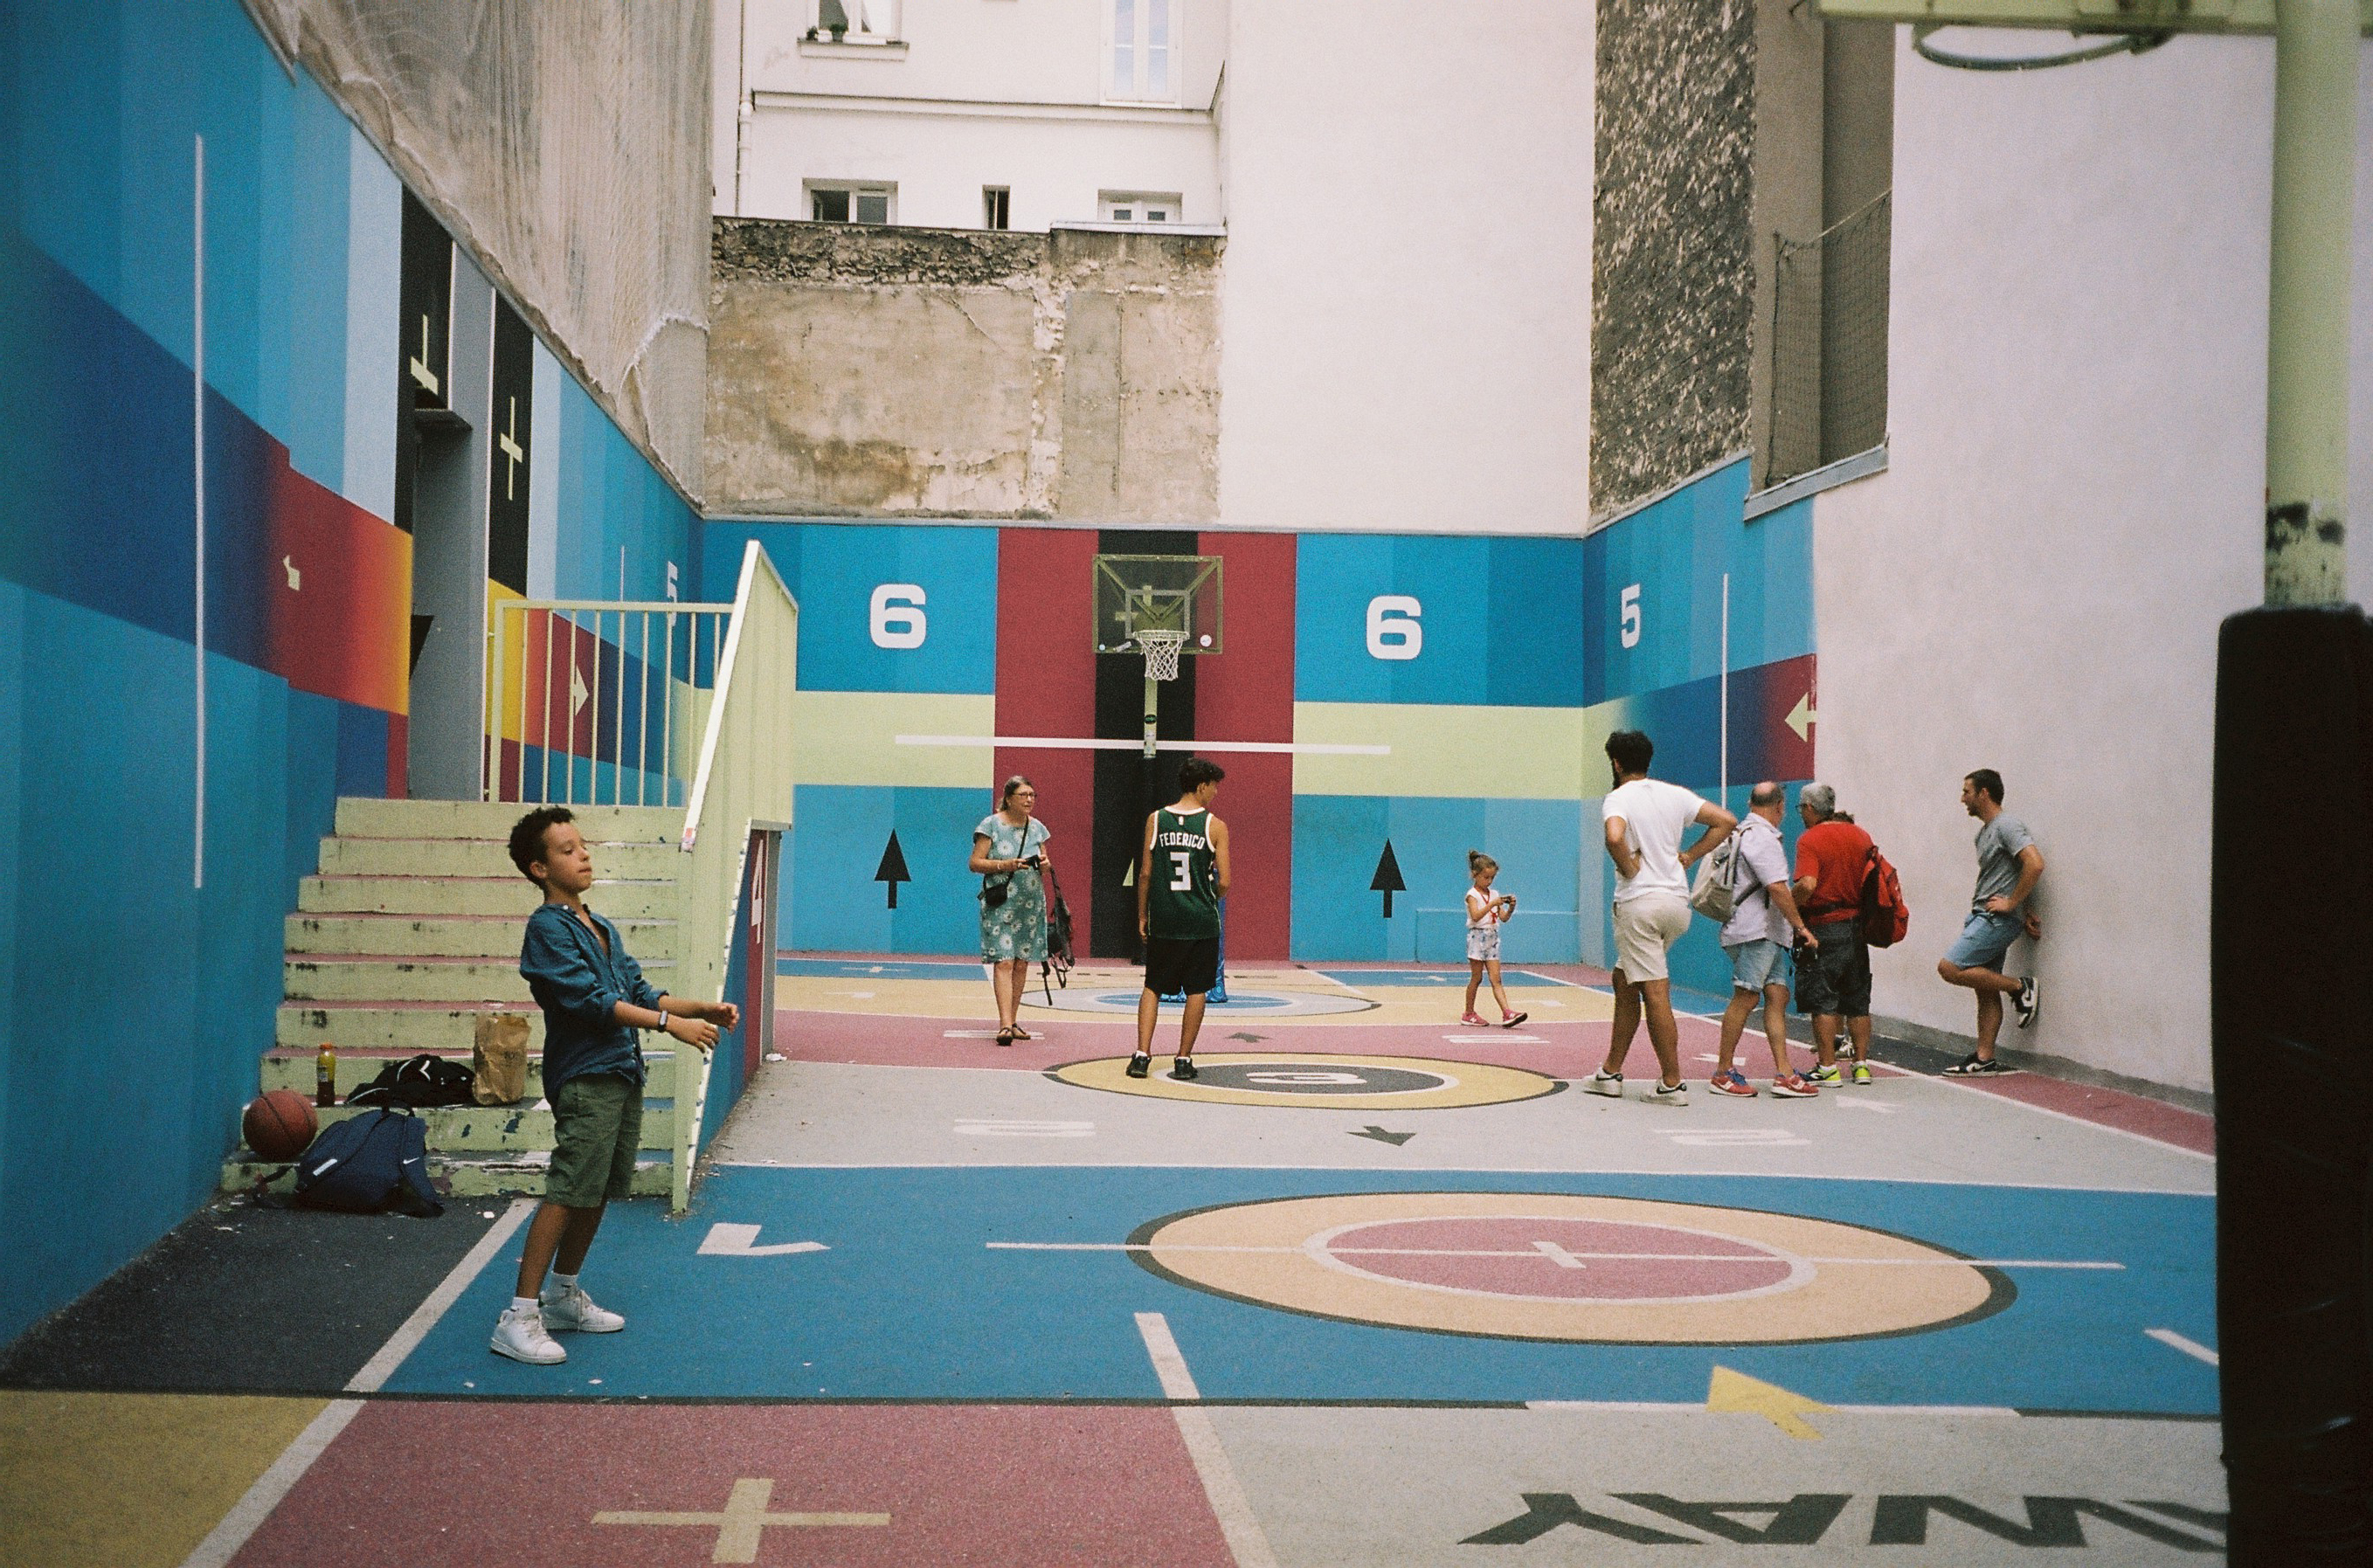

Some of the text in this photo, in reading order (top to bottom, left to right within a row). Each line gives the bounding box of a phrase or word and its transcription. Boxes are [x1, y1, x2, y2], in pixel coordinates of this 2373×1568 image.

[870, 584, 926, 649] 6
[1366, 595, 1422, 660] 6
[1621, 583, 1641, 649] 5
[1159, 832, 1206, 850] FEDERICO
[1170, 852, 1192, 891] 3
[751, 839, 764, 944] 4
